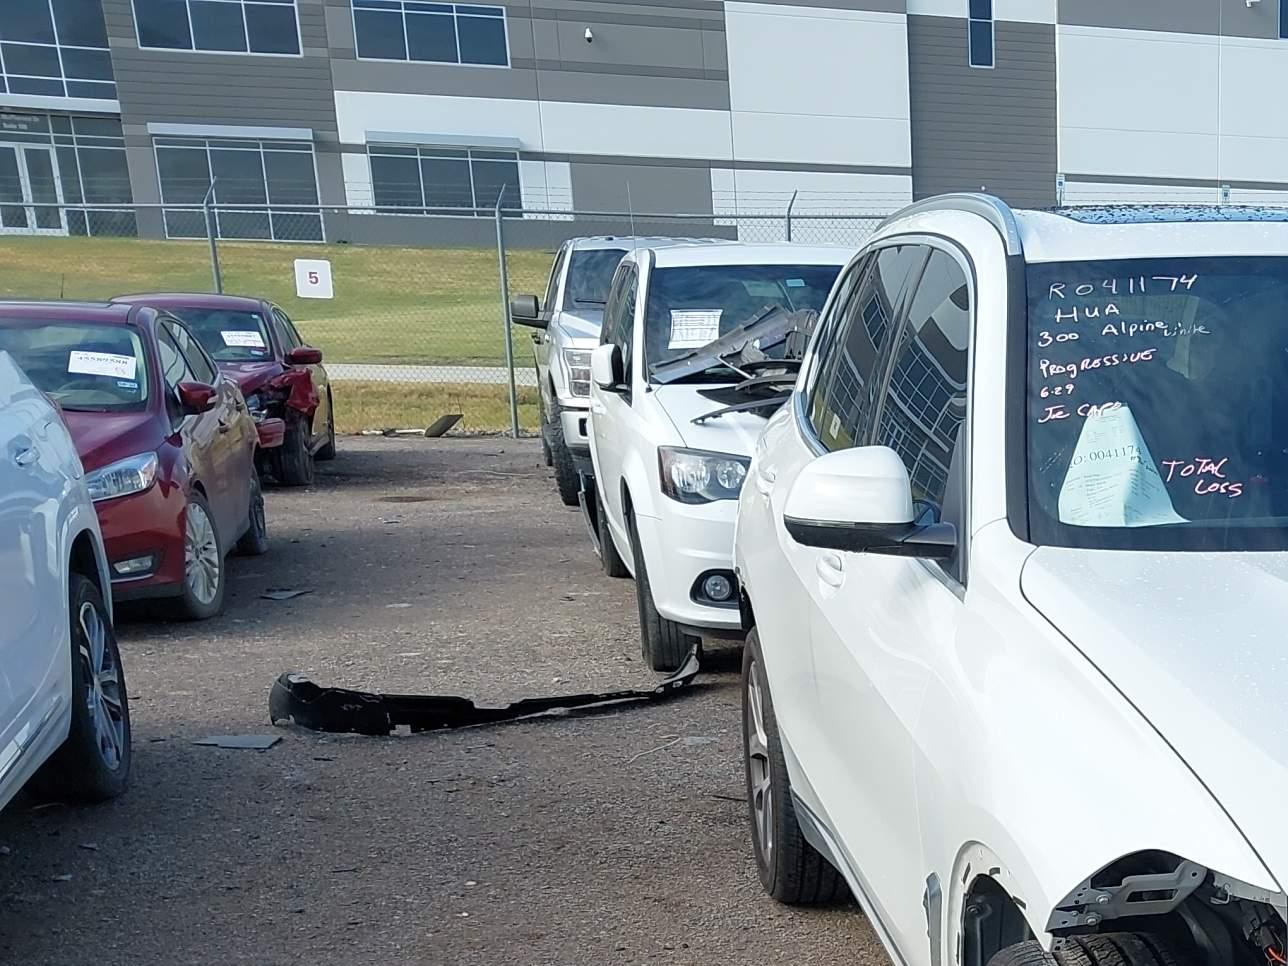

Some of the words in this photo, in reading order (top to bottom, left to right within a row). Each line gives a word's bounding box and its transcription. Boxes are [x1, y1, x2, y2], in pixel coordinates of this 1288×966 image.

[308, 271, 319, 285] 5
[1054, 303, 1120, 322] HUA
[1037, 330, 1079, 347] 300
[1101, 320, 1169, 337] Alpine
[1162, 457, 1228, 482] TOTAL
